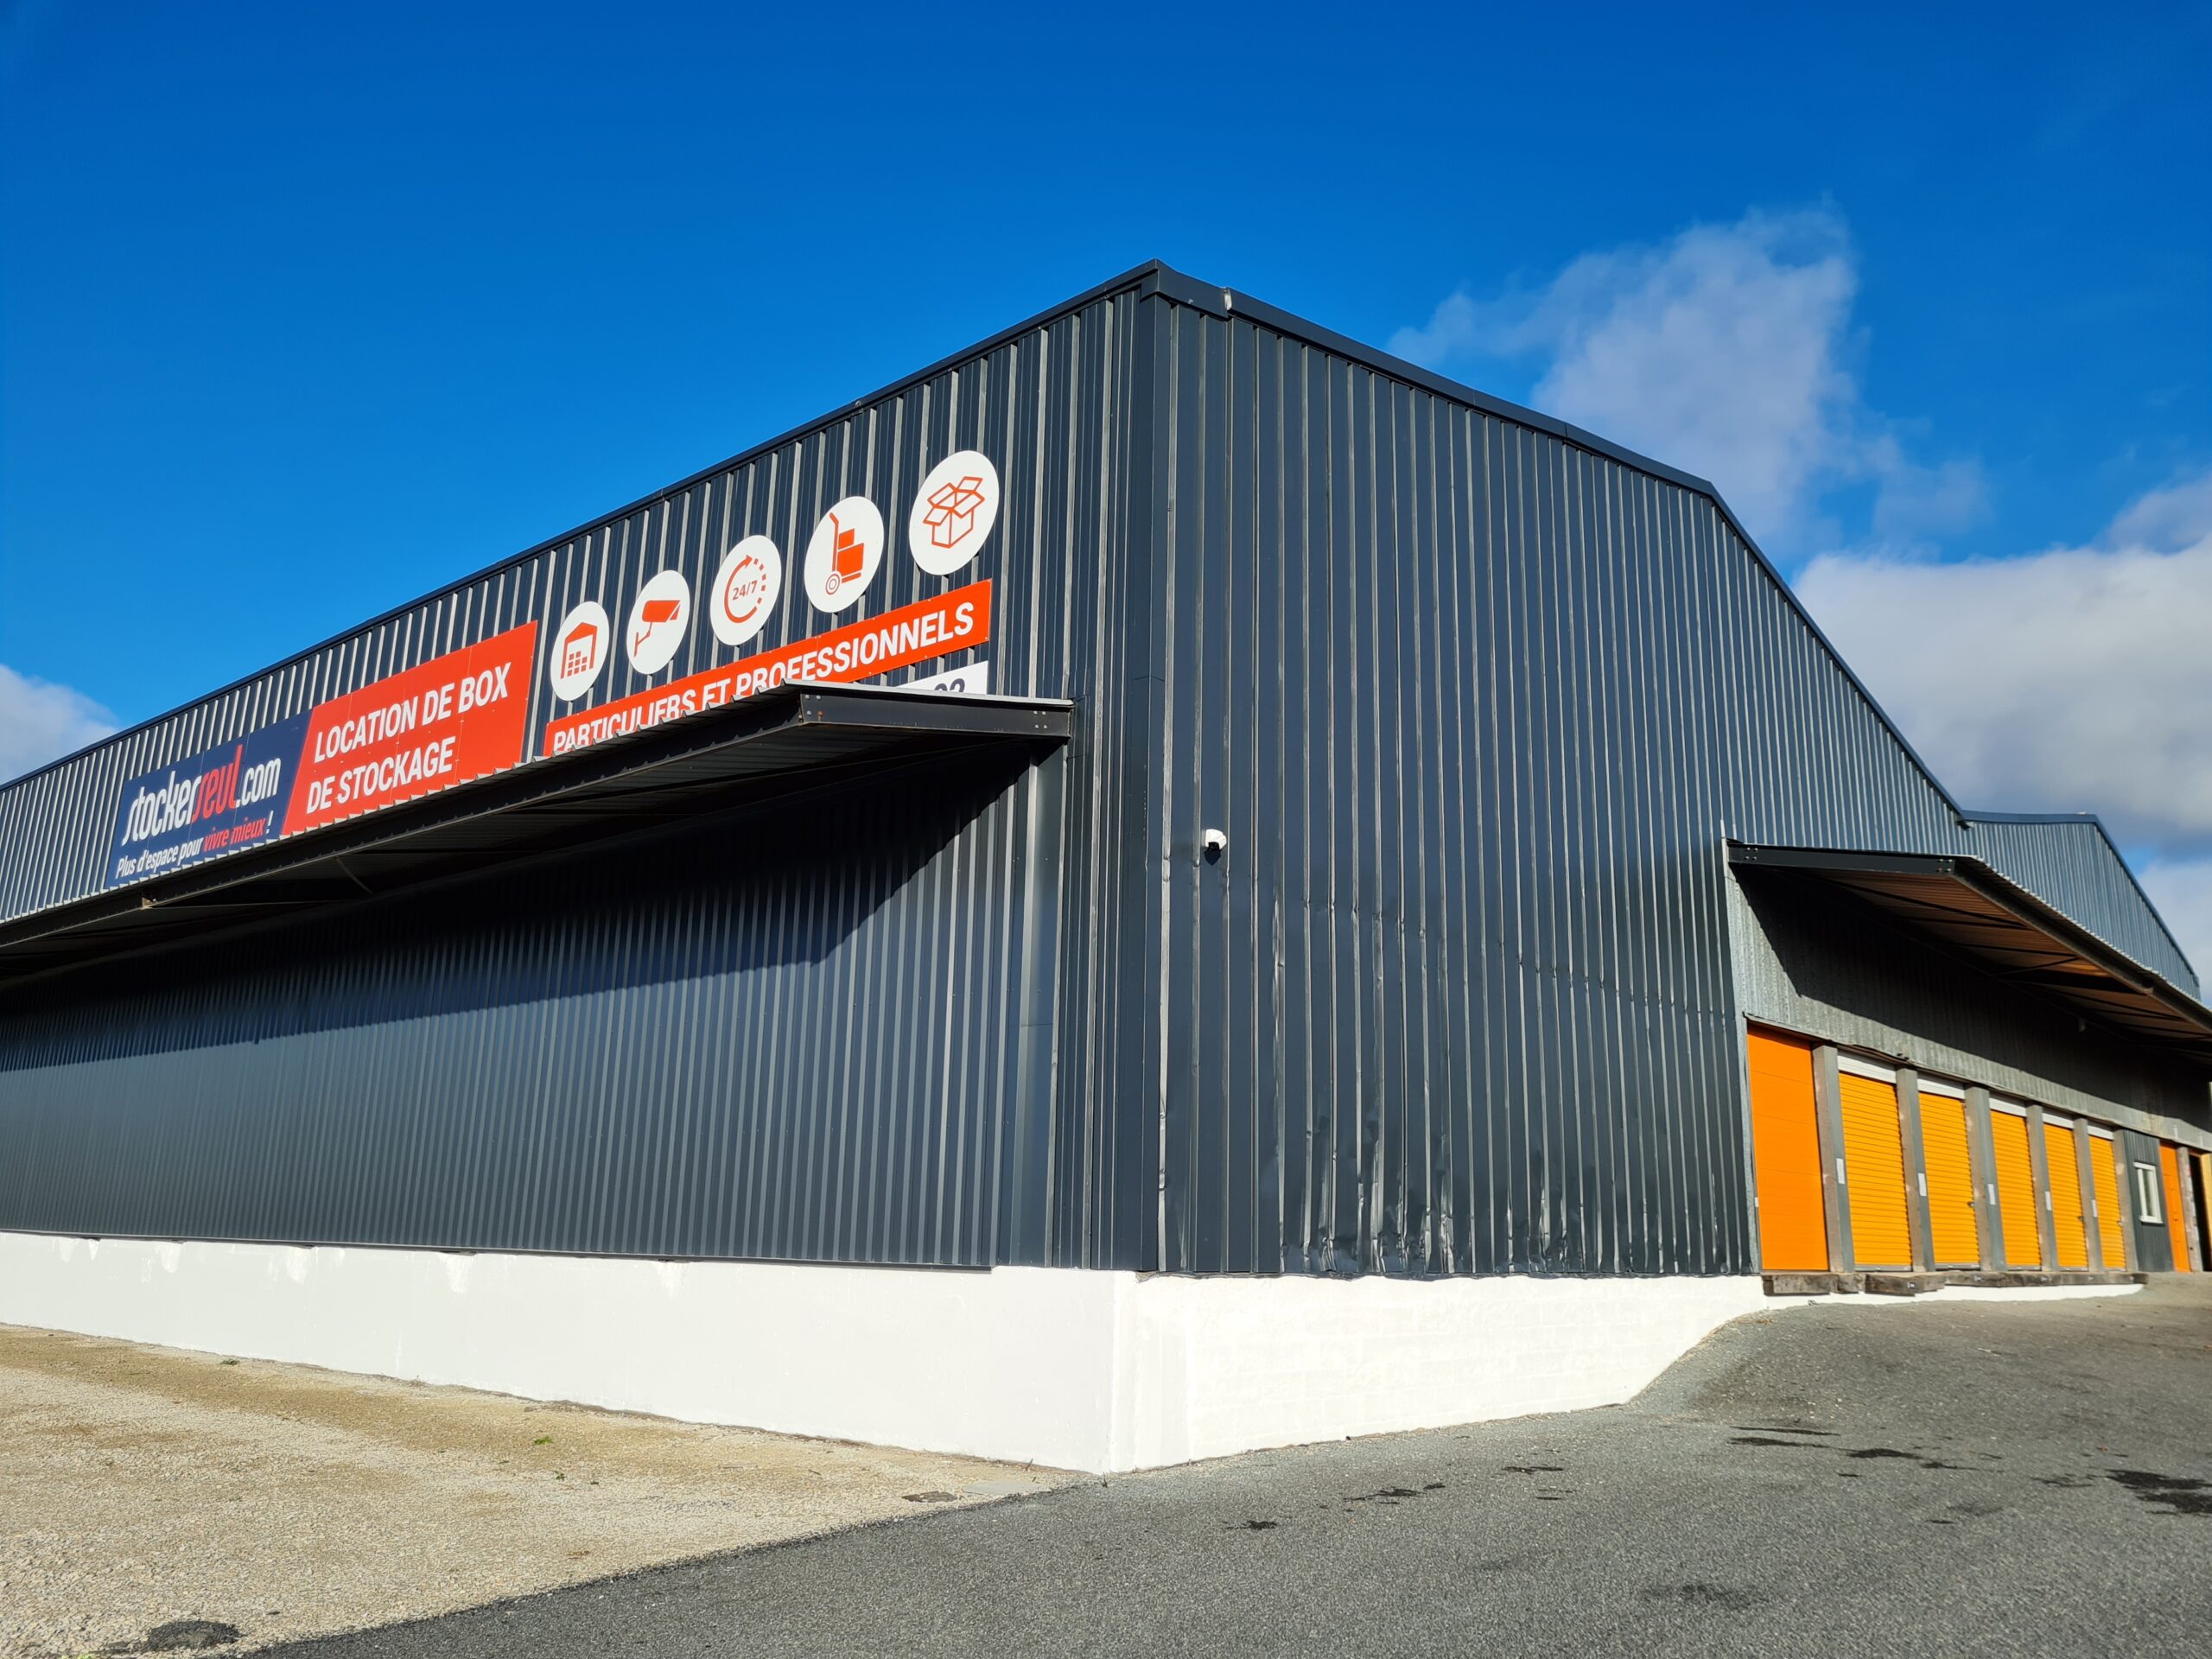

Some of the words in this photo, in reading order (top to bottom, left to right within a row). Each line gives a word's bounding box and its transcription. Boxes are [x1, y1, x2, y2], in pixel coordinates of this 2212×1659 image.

[732, 580, 759, 601] 24/7
[314, 696, 419, 765] LOCATION
[422, 683, 455, 727] DE
[458, 661, 512, 715] BOX
[553, 689, 696, 753] PARTICULIERS
[702, 677, 732, 710] ET
[736, 601, 974, 696] PROFESSIONNELS
[121, 744, 282, 847] stockerseul.com
[306, 775, 336, 815] DE
[337, 735, 456, 804] STOCKAGE
[115, 857, 136, 880] Plus
[137, 846, 179, 874] d'espace
[179, 837, 204, 866] pour
[203, 827, 229, 852] vivre
[231, 817, 267, 845] mieux
